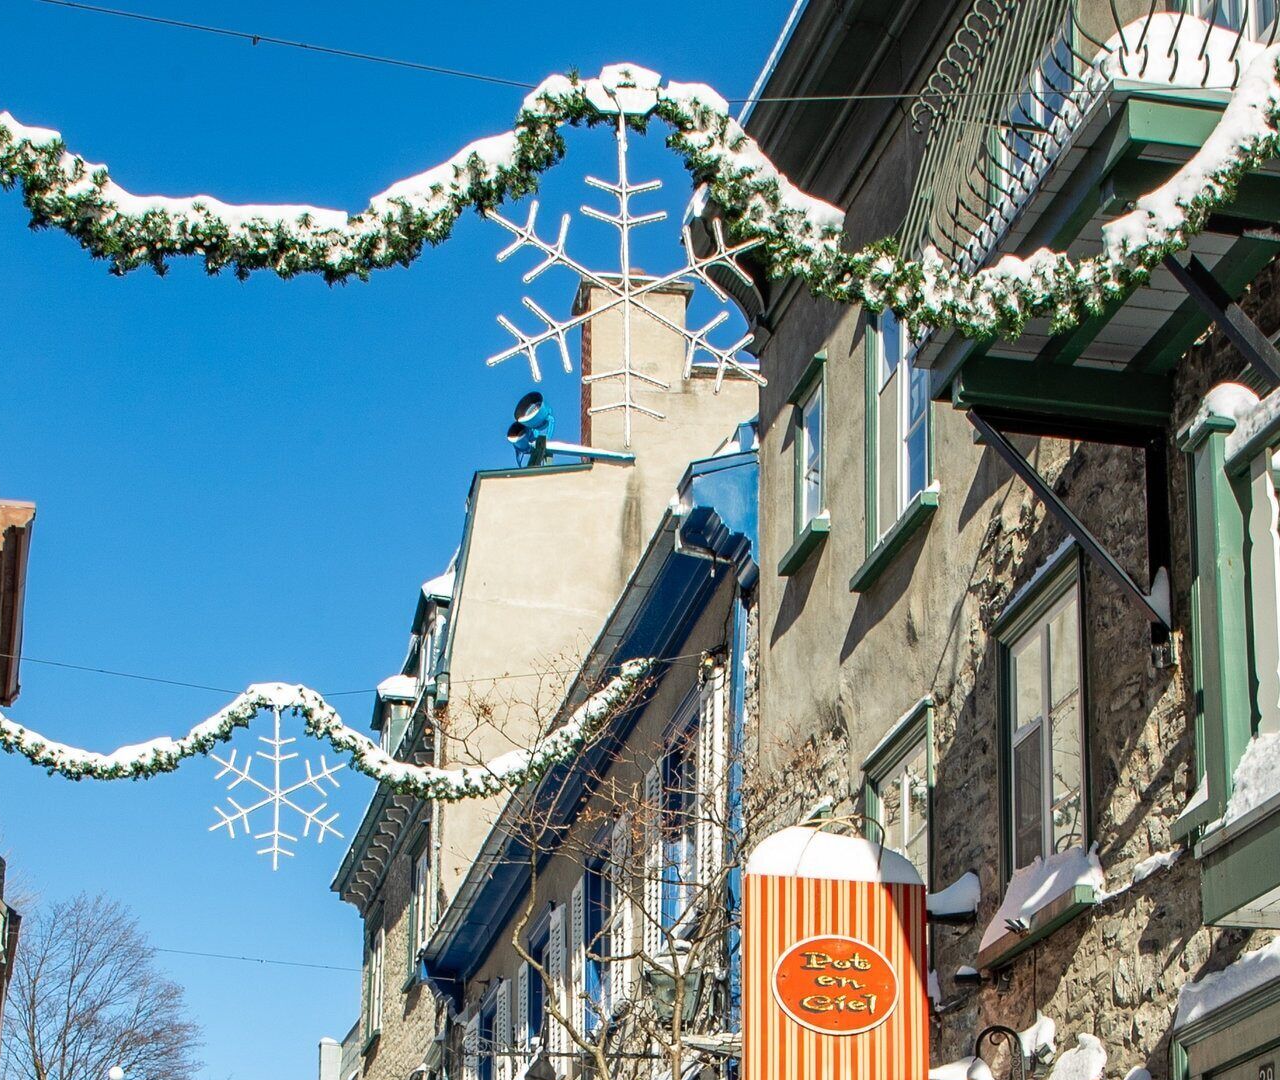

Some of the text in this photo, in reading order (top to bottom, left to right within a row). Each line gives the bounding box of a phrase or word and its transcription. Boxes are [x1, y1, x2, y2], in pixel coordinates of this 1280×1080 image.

[800, 951, 872, 972] Pot
[815, 973, 866, 990] en
[799, 993, 877, 1015] Ciel
